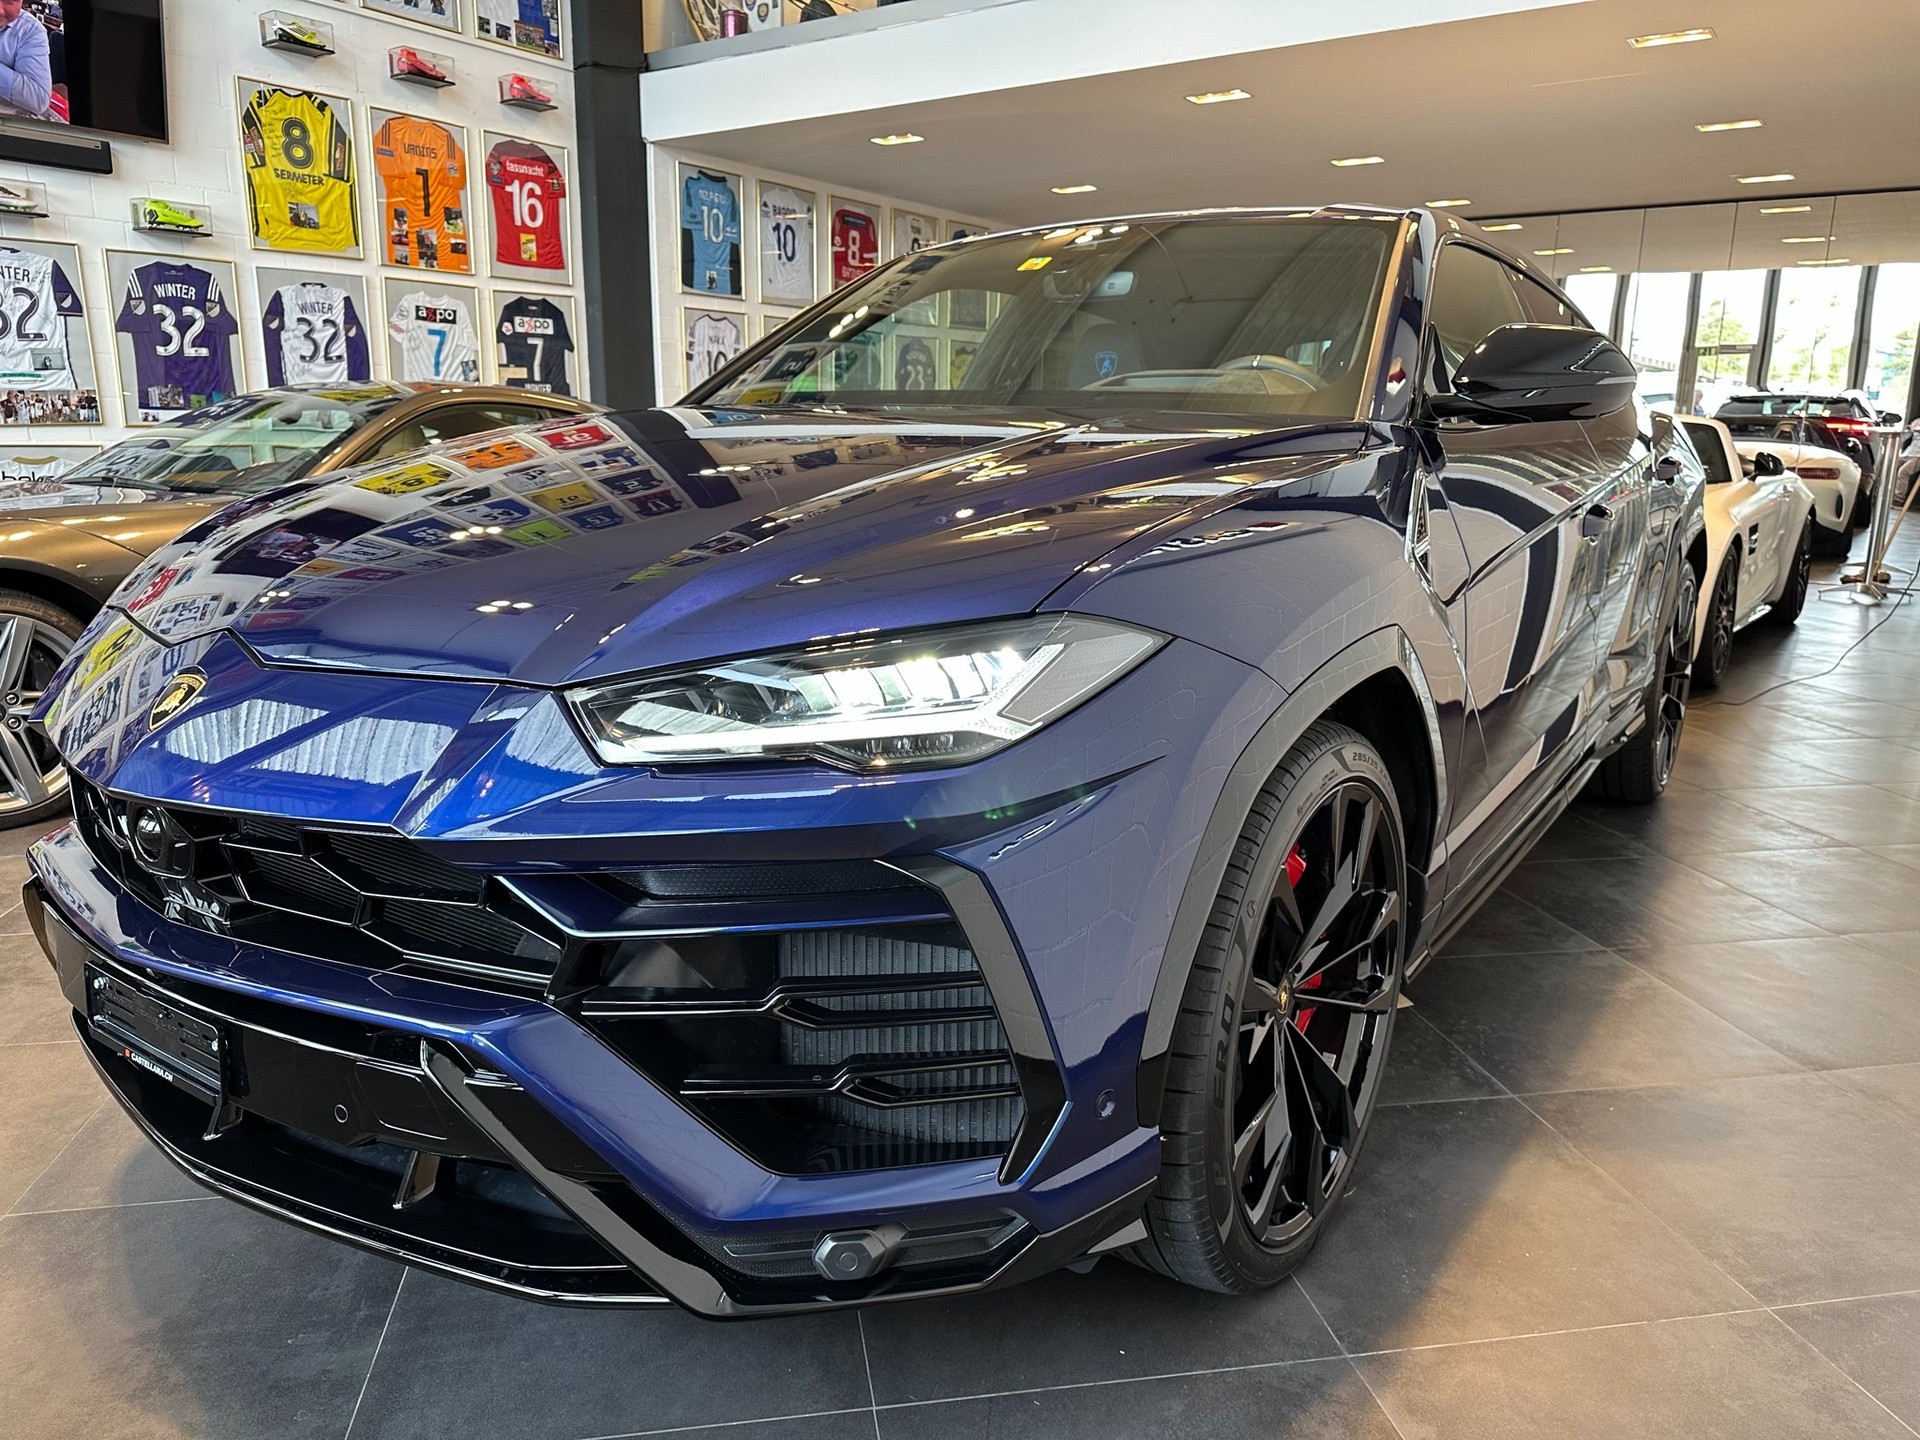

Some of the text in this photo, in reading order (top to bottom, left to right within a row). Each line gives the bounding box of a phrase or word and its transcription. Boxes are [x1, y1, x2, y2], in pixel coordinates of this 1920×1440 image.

[281, 116, 315, 170] 8
[415, 167, 431, 217] 1
[504, 179, 544, 228] 16
[701, 205, 724, 243] 10
[772, 222, 796, 262] 10
[847, 230, 860, 266] 8
[153, 283, 196, 300] WINTER
[298, 301, 334, 315] WINTER
[152, 303, 210, 357] 32
[296, 317, 346, 364] 32
[427, 328, 447, 377] 7
[527, 337, 545, 381] 7
[131, 1052, 174, 1082] CASTELLANA.CH
